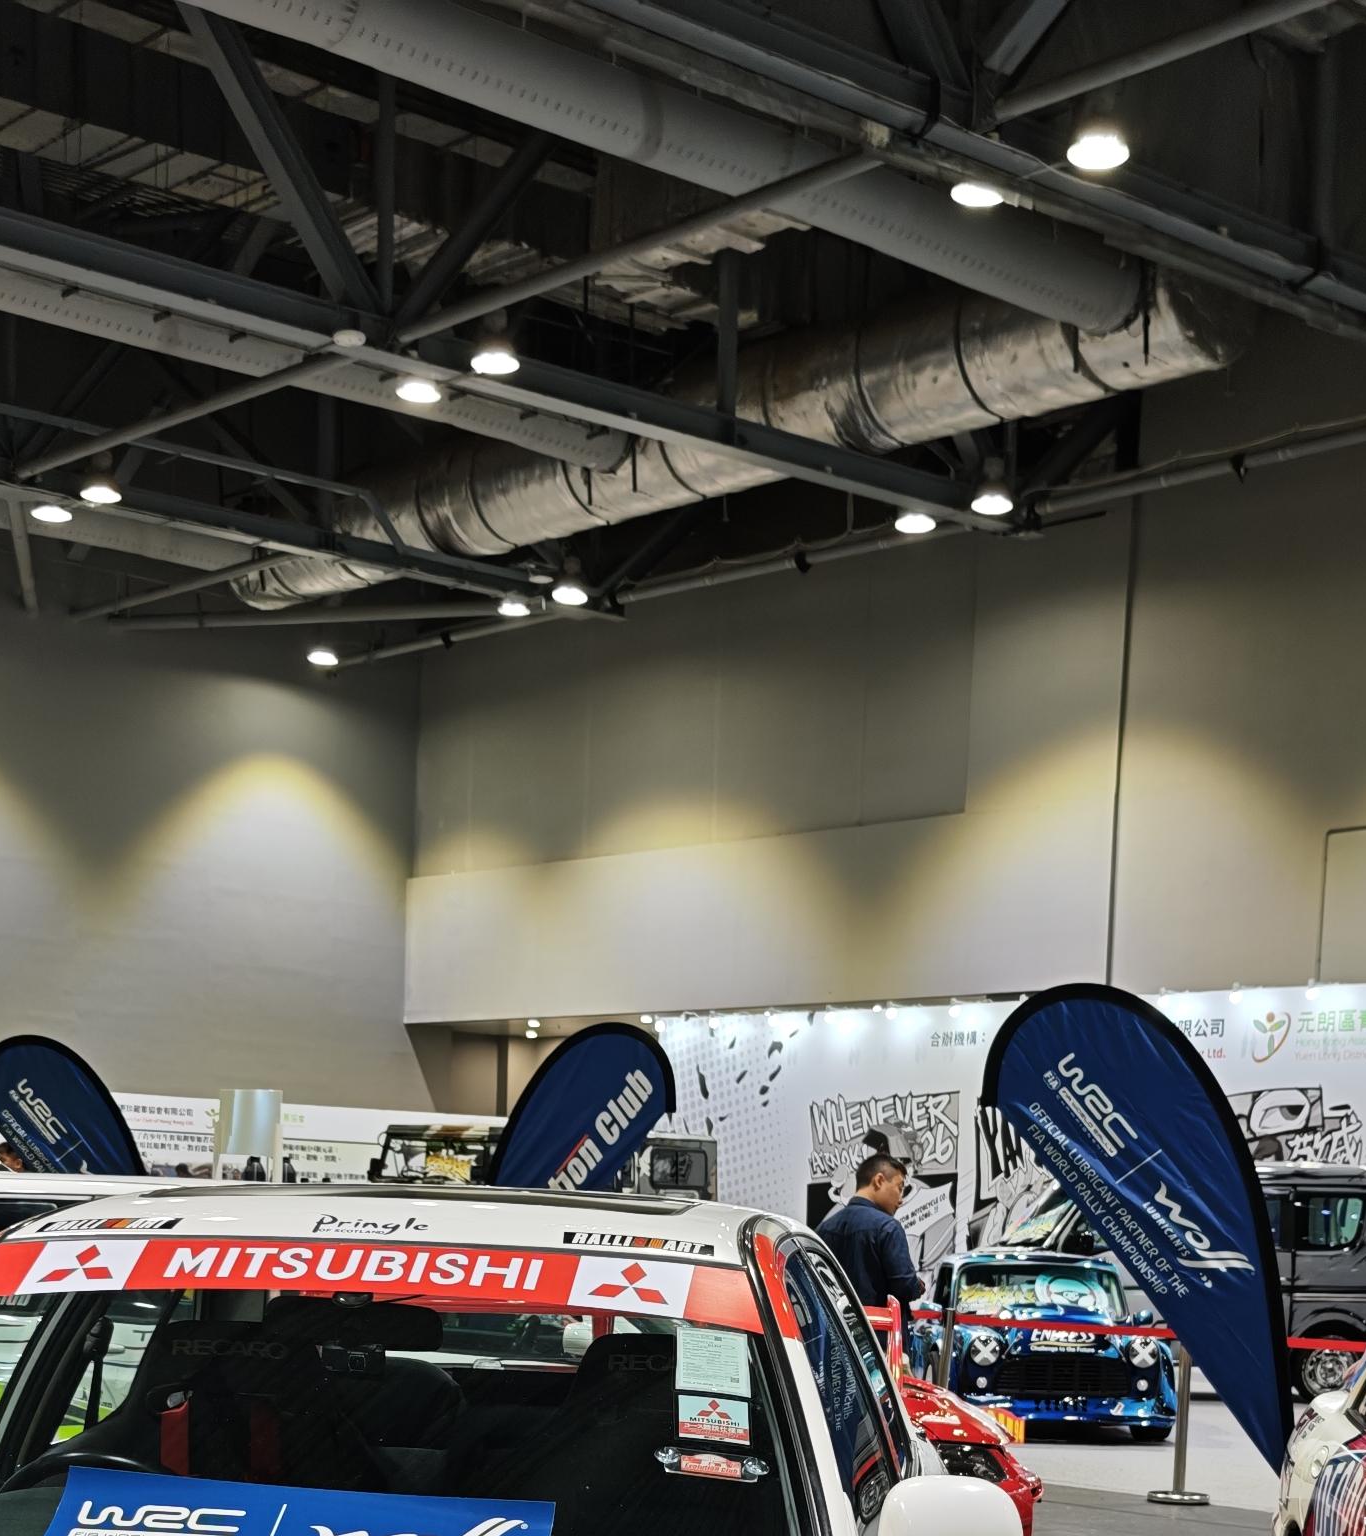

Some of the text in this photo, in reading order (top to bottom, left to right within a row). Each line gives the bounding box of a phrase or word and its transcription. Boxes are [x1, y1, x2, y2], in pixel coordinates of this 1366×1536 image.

[1171, 1016, 1226, 1040] 限公司
[594, 1068, 655, 1146] Club
[1057, 1052, 1139, 1150] WRC
[1027, 1123, 1046, 1145] FIA
[1043, 1142, 1079, 1183] WORLD
[1074, 1180, 1105, 1217] RALLY
[1101, 1214, 1169, 1296] CHAMPIONSHIP
[1028, 1102, 1070, 1150] OFFICIAL
[1068, 1147, 1122, 1209] LUBRICANT
[1115, 1206, 1159, 1260] PARTNER
[1155, 1255, 1172, 1275] OF
[1167, 1271, 1190, 1299] THE
[311, 1218, 429, 1238] Pringle
[571, 1233, 706, 1254] RALLI ART
[1141, 1201, 1192, 1258] LUBRICANTS
[162, 1245, 545, 1292] MITSUBISHI
[688, 1416, 740, 1427] MITSUBISHI
[77, 1500, 247, 1533] WRC
